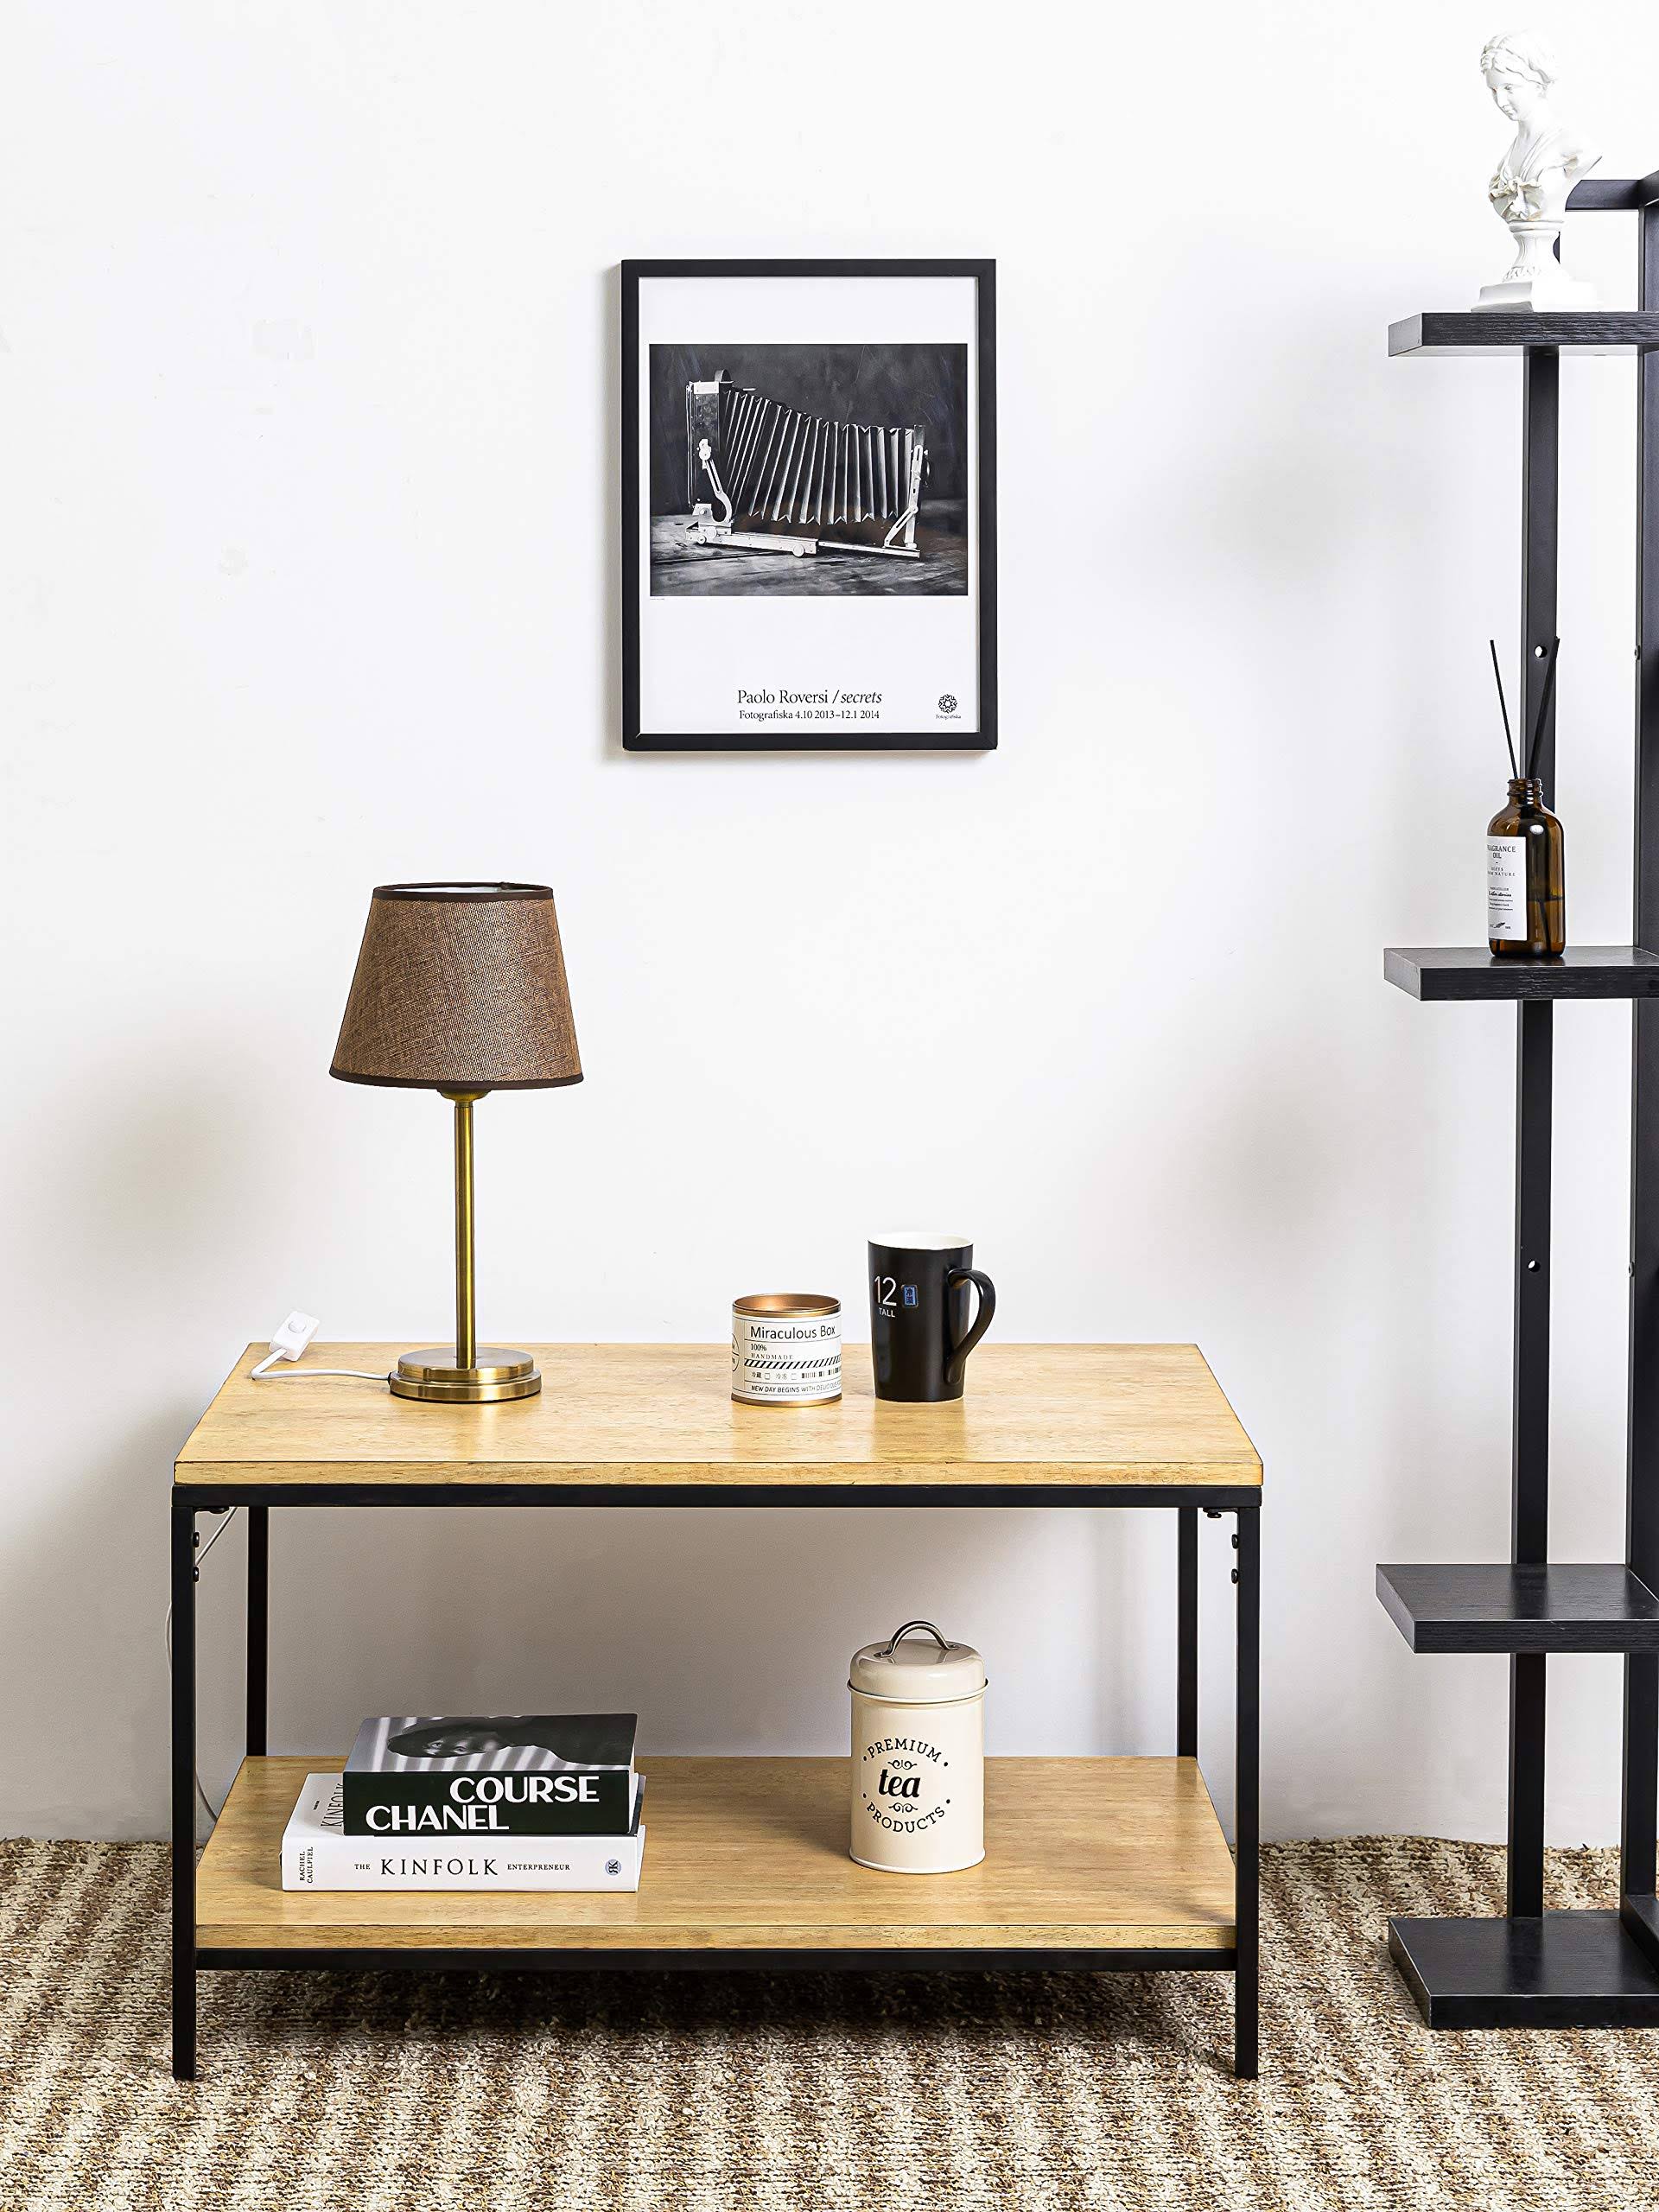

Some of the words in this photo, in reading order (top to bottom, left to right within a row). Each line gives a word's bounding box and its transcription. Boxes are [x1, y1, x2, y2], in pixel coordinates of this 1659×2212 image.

[737, 689, 775, 704] Paolo
[779, 689, 829, 704] Roversi
[739, 709, 793, 721] Fotografiska
[794, 710, 813, 720] 4.10
[860, 710, 880, 720] 2014
[874, 1275, 897, 1306] 12
[878, 1306, 896, 1318] TALL
[750, 1325, 817, 1339] Miraculous
[820, 1325, 836, 1338] Box
[750, 1343, 767, 1351] 100%
[867, 1738, 942, 1763] PREMIUM
[449, 1776, 600, 1803] COURSE
[878, 1769, 921, 1798] tea
[365, 1804, 510, 1831] CHANEL
[866, 1802, 945, 1834] PRODUCTS
[380, 1858, 499, 1876] KINFOLK
